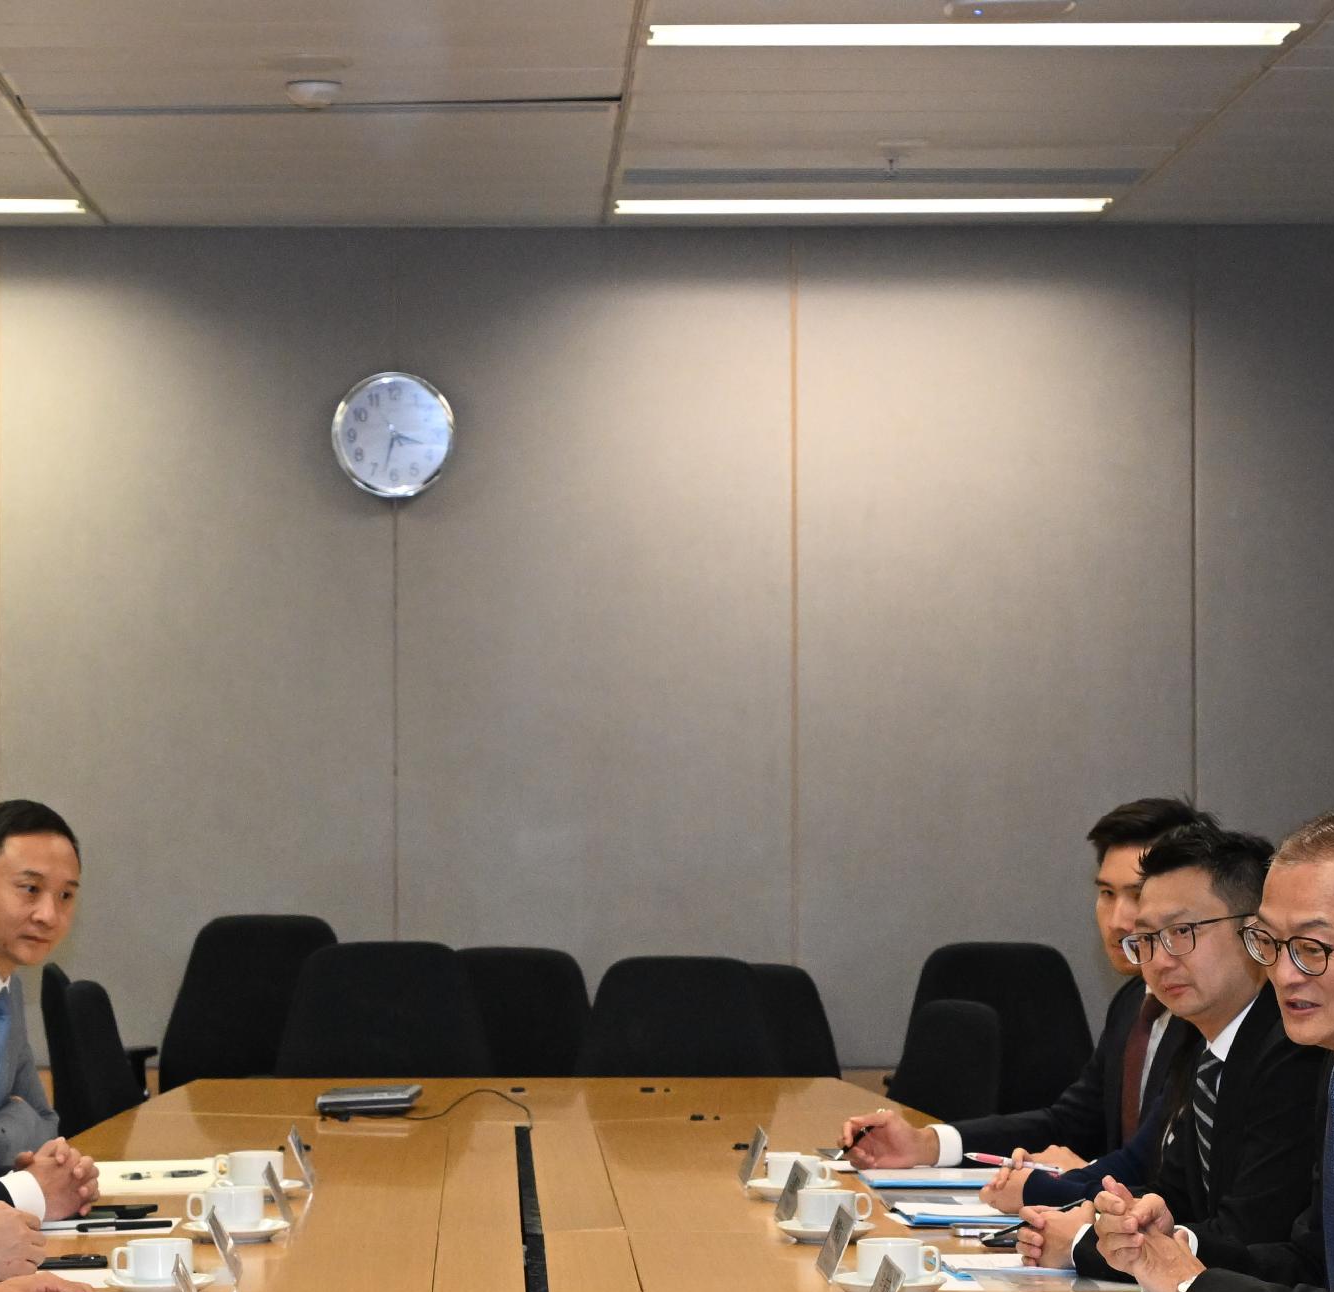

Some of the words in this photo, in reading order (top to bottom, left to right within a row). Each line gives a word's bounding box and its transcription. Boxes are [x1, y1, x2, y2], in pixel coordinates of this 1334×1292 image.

[367, 393, 380, 407] 11
[388, 387, 402, 401] 12
[353, 407, 368, 422] 10
[347, 428, 357, 443] 9
[354, 447, 364, 462] 8
[370, 461, 379, 476] 7
[389, 467, 399, 481] 6
[410, 462, 420, 476] 5
